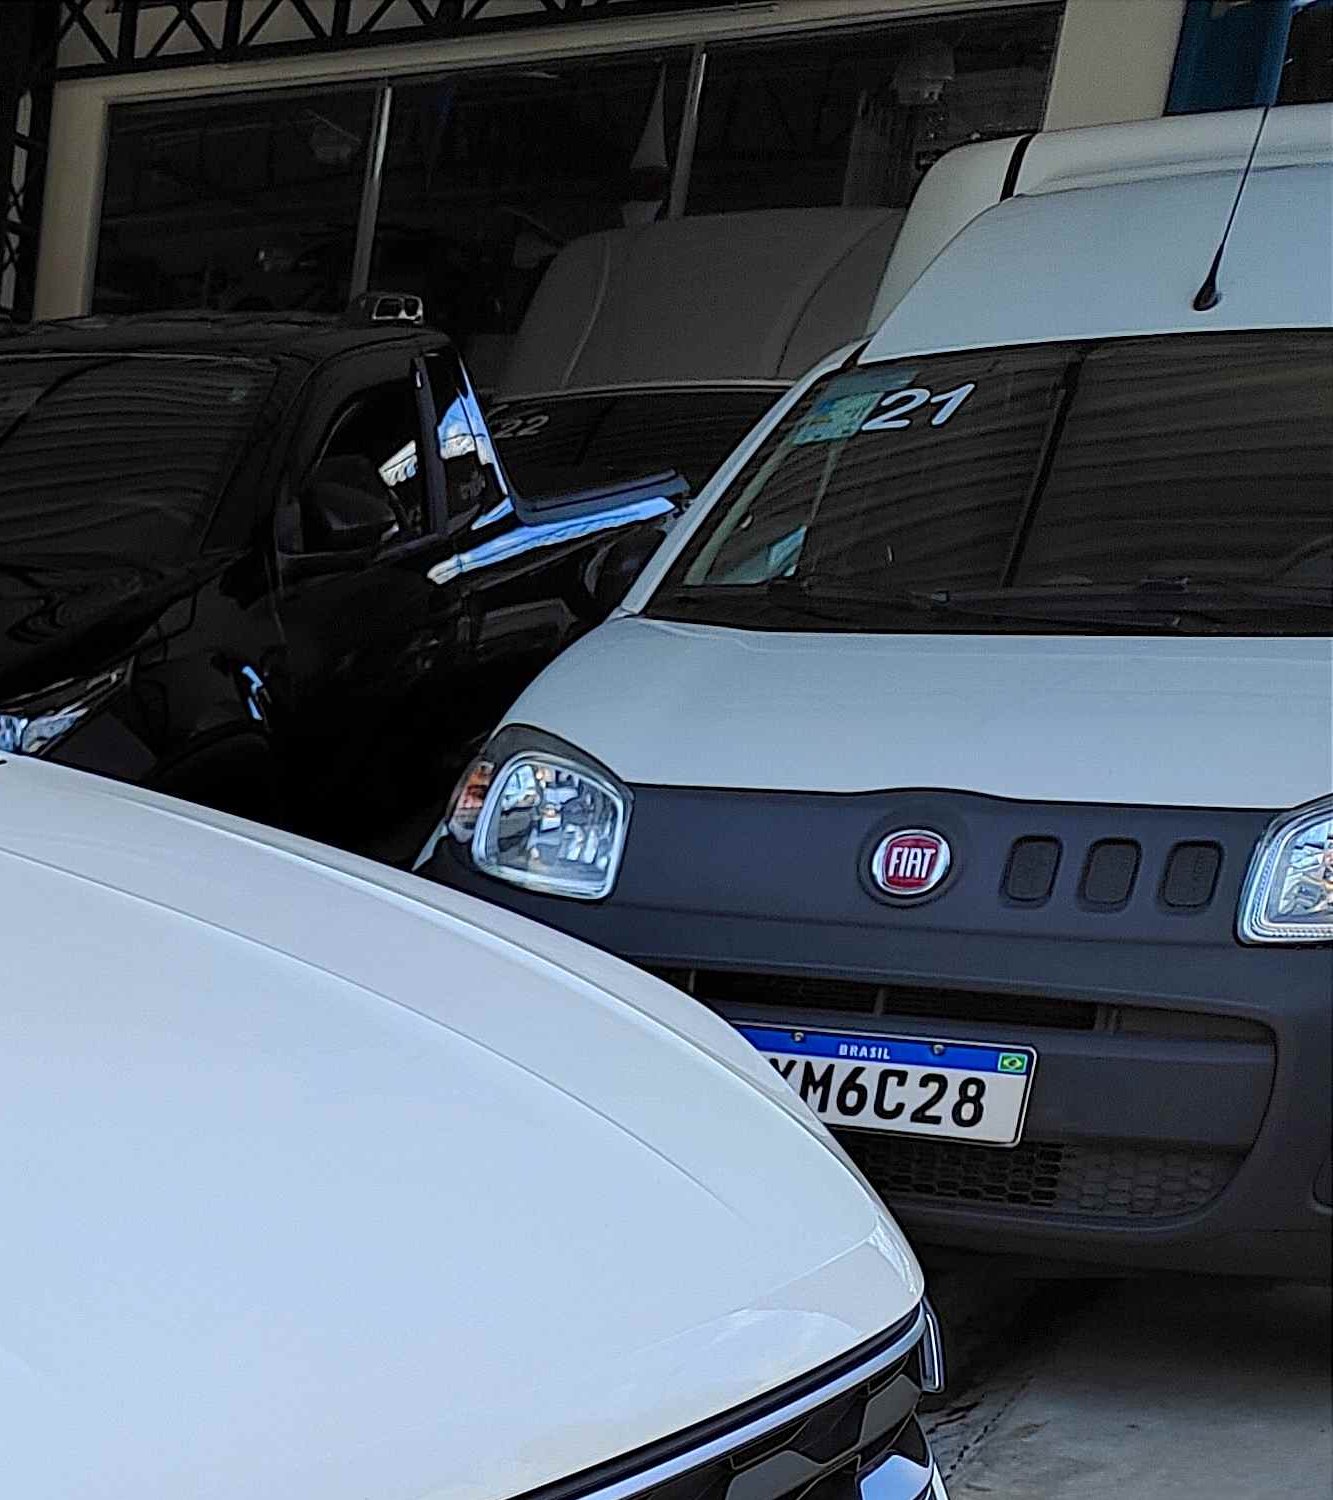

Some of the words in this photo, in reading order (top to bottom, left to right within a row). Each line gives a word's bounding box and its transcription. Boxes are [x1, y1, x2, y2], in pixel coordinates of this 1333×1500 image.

[861, 382, 976, 432] 21
[887, 846, 937, 879] FIAT
[837, 1042, 891, 1061] BRASIL
